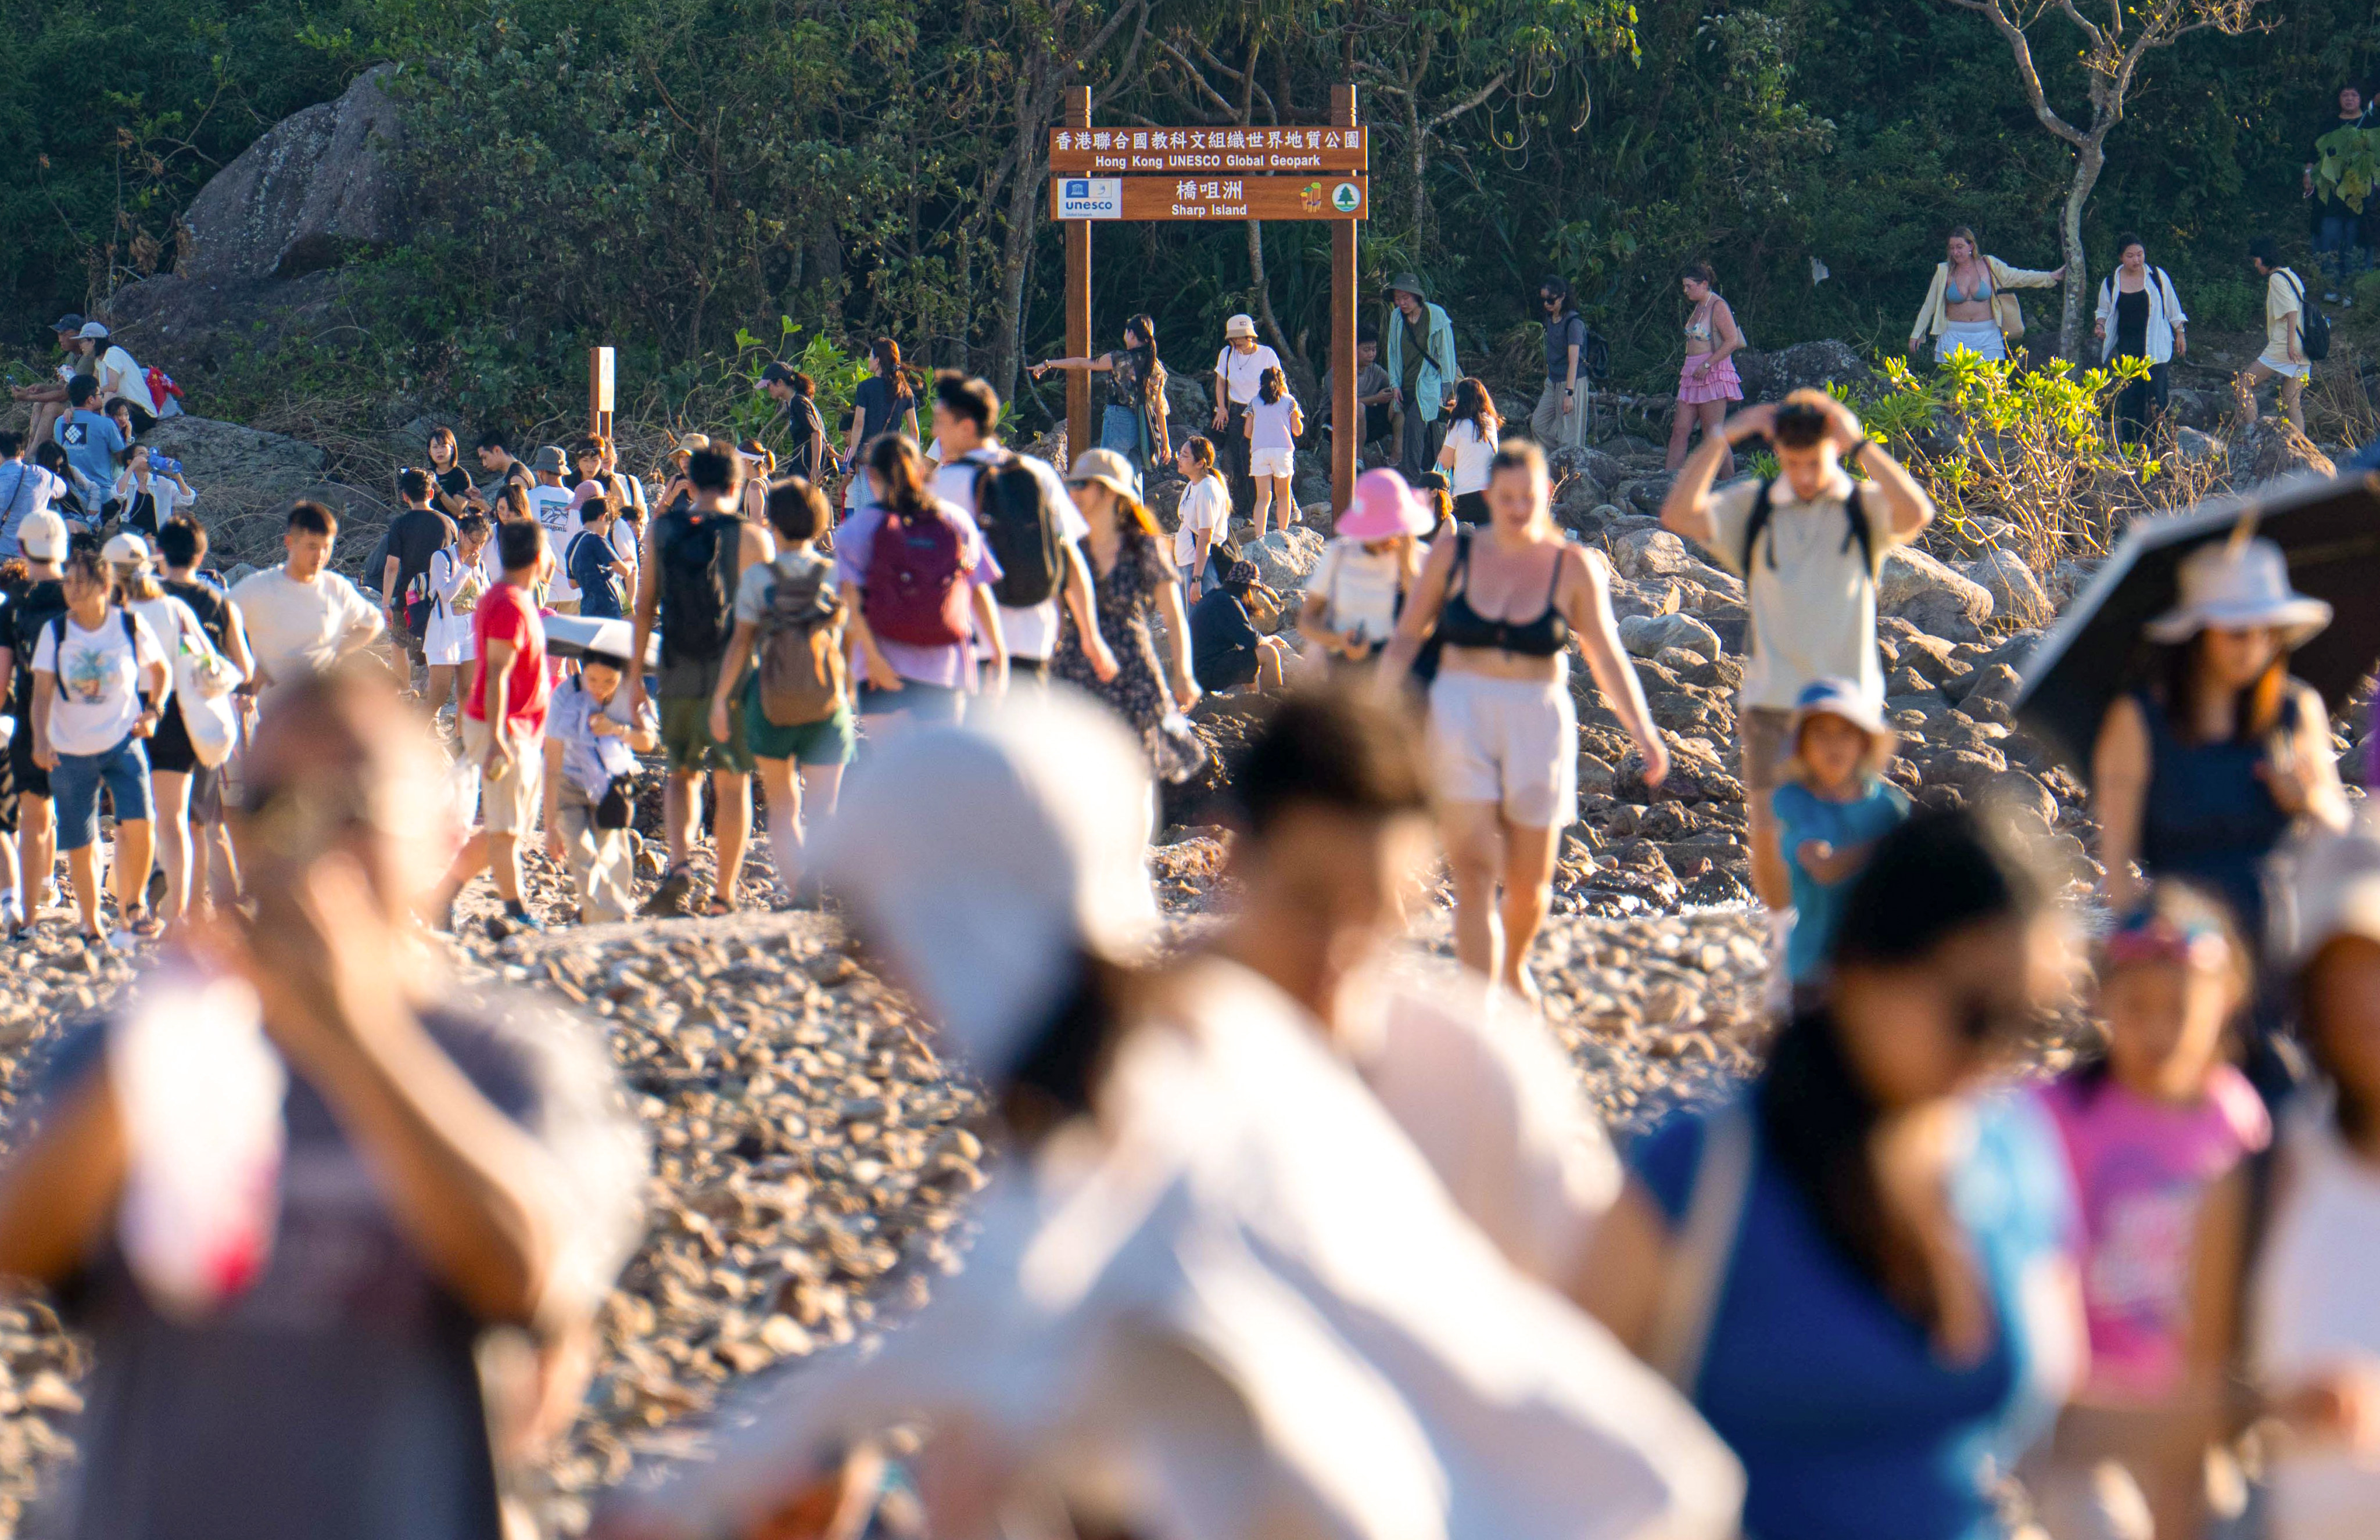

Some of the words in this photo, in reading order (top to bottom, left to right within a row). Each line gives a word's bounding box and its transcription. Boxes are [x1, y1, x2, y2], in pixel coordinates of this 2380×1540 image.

[1055, 131, 1359, 150] 香港聯合國教科文組織世界地質公園
[1095, 155, 1126, 169] Hong
[1132, 155, 1163, 169] Kong
[1169, 155, 1220, 167] UNESCO
[1226, 155, 1264, 166] Global
[1270, 155, 1321, 168] Geopark
[1176, 180, 1243, 200] 橋咀洲
[1066, 202, 1112, 210] unesco
[1171, 204, 1206, 218] Sharp
[1211, 204, 1247, 216] Island
